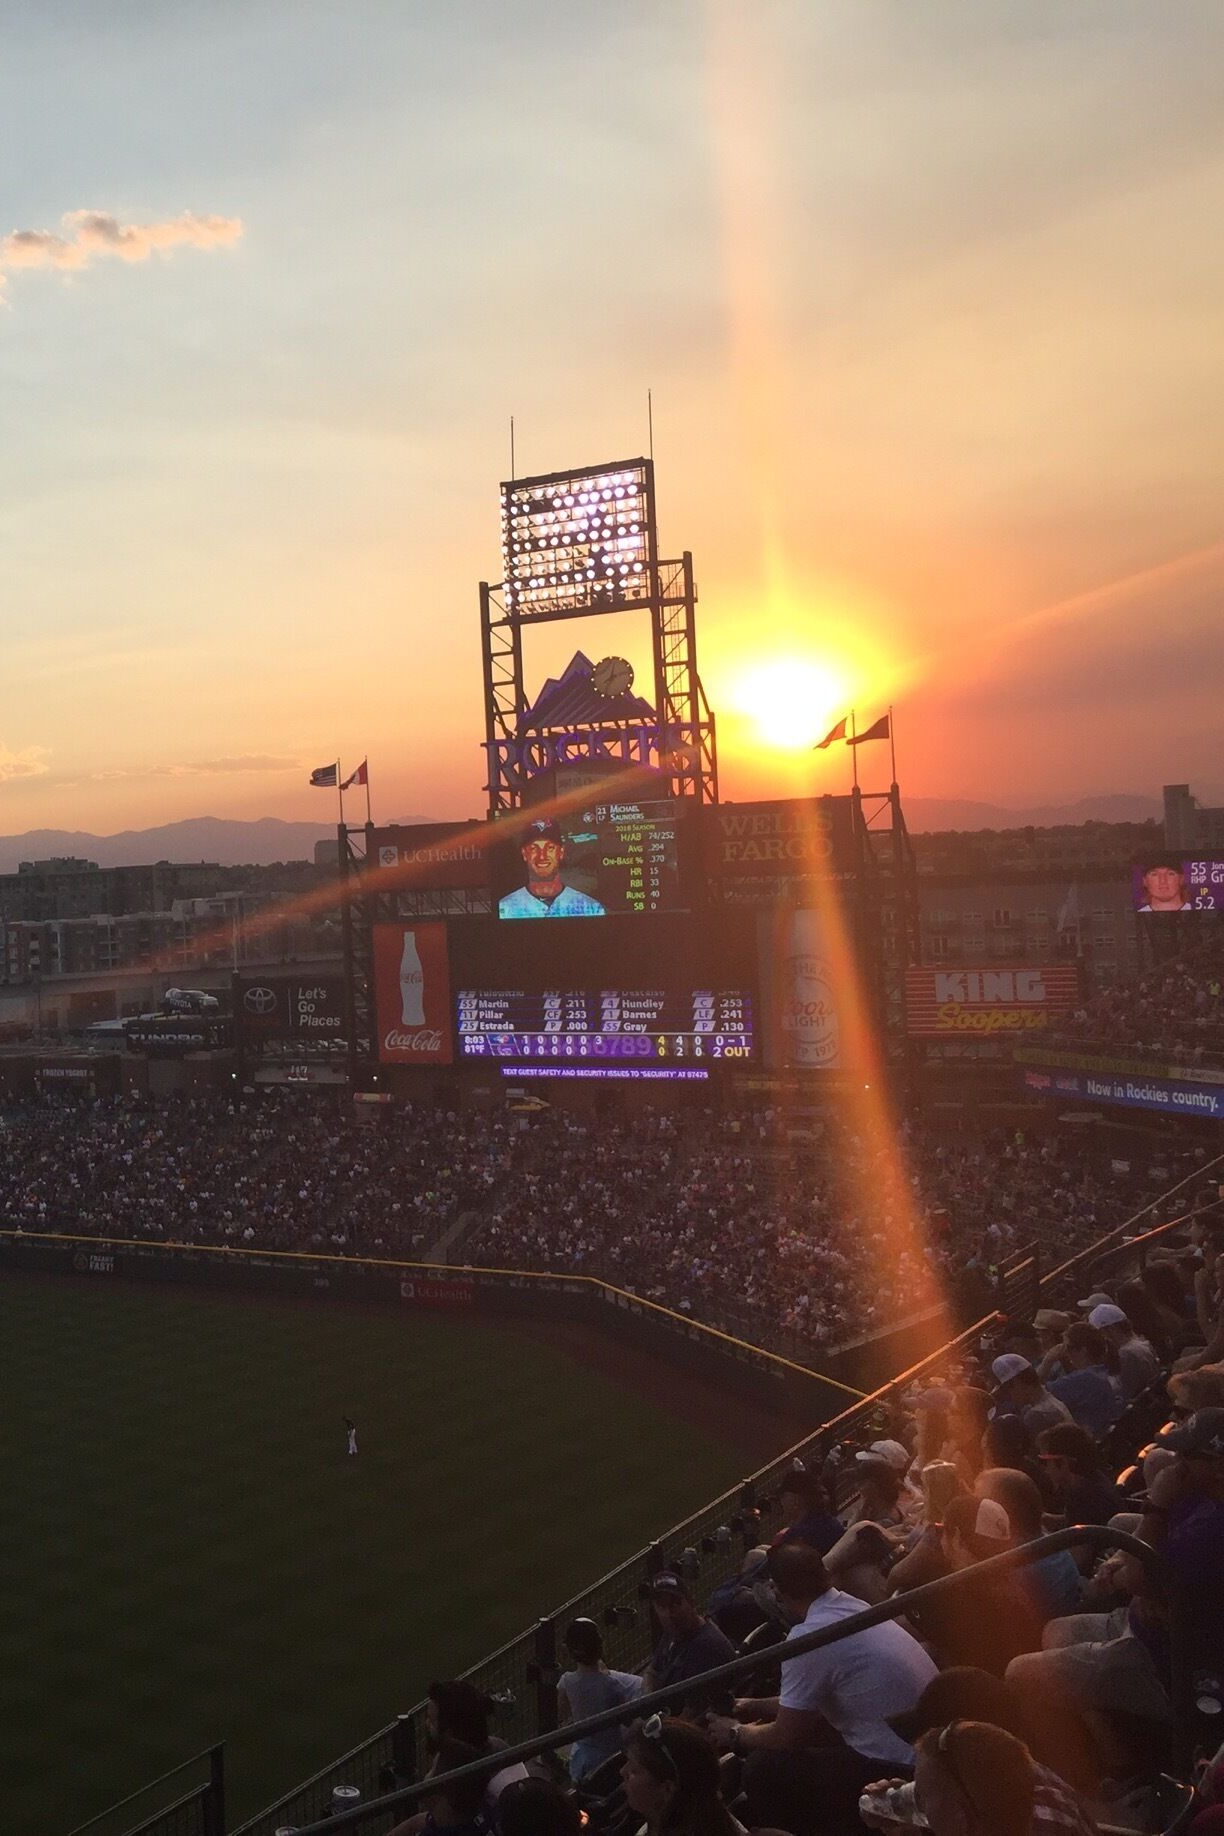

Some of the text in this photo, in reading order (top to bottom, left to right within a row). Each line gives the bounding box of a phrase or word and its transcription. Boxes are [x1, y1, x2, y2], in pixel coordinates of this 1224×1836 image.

[480, 723, 698, 792] ROCKIES
[597, 804, 639, 815] 21 MICHAEL
[610, 812, 644, 821] SAUNDERS
[632, 823, 656, 831] SEASON
[718, 812, 833, 836] WELLS
[620, 831, 674, 842] H/AB 74/252
[404, 845, 482, 864] UCHealth
[721, 838, 833, 862] FARGO
[630, 868, 642, 876] HR
[1191, 862, 1206, 876] 55
[630, 880, 643, 888] RBI
[1191, 875, 1206, 884] RHP
[626, 892, 645, 900] RUNS
[1200, 888, 1209, 896] IP
[1195, 896, 1215, 911] 5.2
[935, 970, 1046, 1003] KING
[297, 986, 328, 1000] Let's
[169, 998, 192, 1009] TOYOTA
[297, 1000, 317, 1014] Go
[478, 999, 509, 1008] Martin
[566, 1000, 586, 1008] .211
[622, 1000, 664, 1010] Hundley
[719, 999, 743, 1008] .253
[479, 1010, 504, 1019] Pillar
[548, 1011, 561, 1019] CF
[566, 1011, 587, 1020] .253
[622, 1010, 657, 1019] Barnes
[698, 1010, 710, 1018] LF
[720, 1010, 742, 1019] .241
[936, 1002, 1047, 1036] Soopers
[298, 1014, 342, 1027] Places
[479, 1021, 514, 1030] Estrada
[566, 1022, 588, 1030] .000
[623, 1022, 647, 1033] Gray
[720, 1022, 744, 1032] .130
[384, 1029, 445, 1051] Coca-Cola
[464, 1035, 485, 1044] 8:03
[537, 1035, 544, 1045] 0
[551, 1035, 558, 1045] 0
[566, 1035, 573, 1045] 0
[580, 1035, 587, 1045] 0
[595, 1035, 602, 1045] 3
[657, 1036, 665, 1045] 4
[675, 1036, 683, 1045] 4
[694, 1036, 702, 1046] 0
[715, 1036, 725, 1046] 0
[523, 1045, 530, 1055] 0
[538, 1045, 545, 1055] 0
[551, 1045, 558, 1055] 0
[566, 1045, 573, 1055] 0
[580, 1045, 587, 1055] 0
[658, 1046, 666, 1056] 0
[676, 1046, 684, 1056] 2
[694, 1046, 703, 1056] 0
[712, 1046, 722, 1057] 2
[723, 1046, 751, 1058] OUT
[518, 1068, 537, 1076] GUEST
[640, 1070, 677, 1078] "SECURITY"
[1087, 1079, 1111, 1097] Now
[1113, 1081, 1124, 1098] in
[1126, 1083, 1168, 1104] Rockies
[1172, 1090, 1219, 1113] country.
